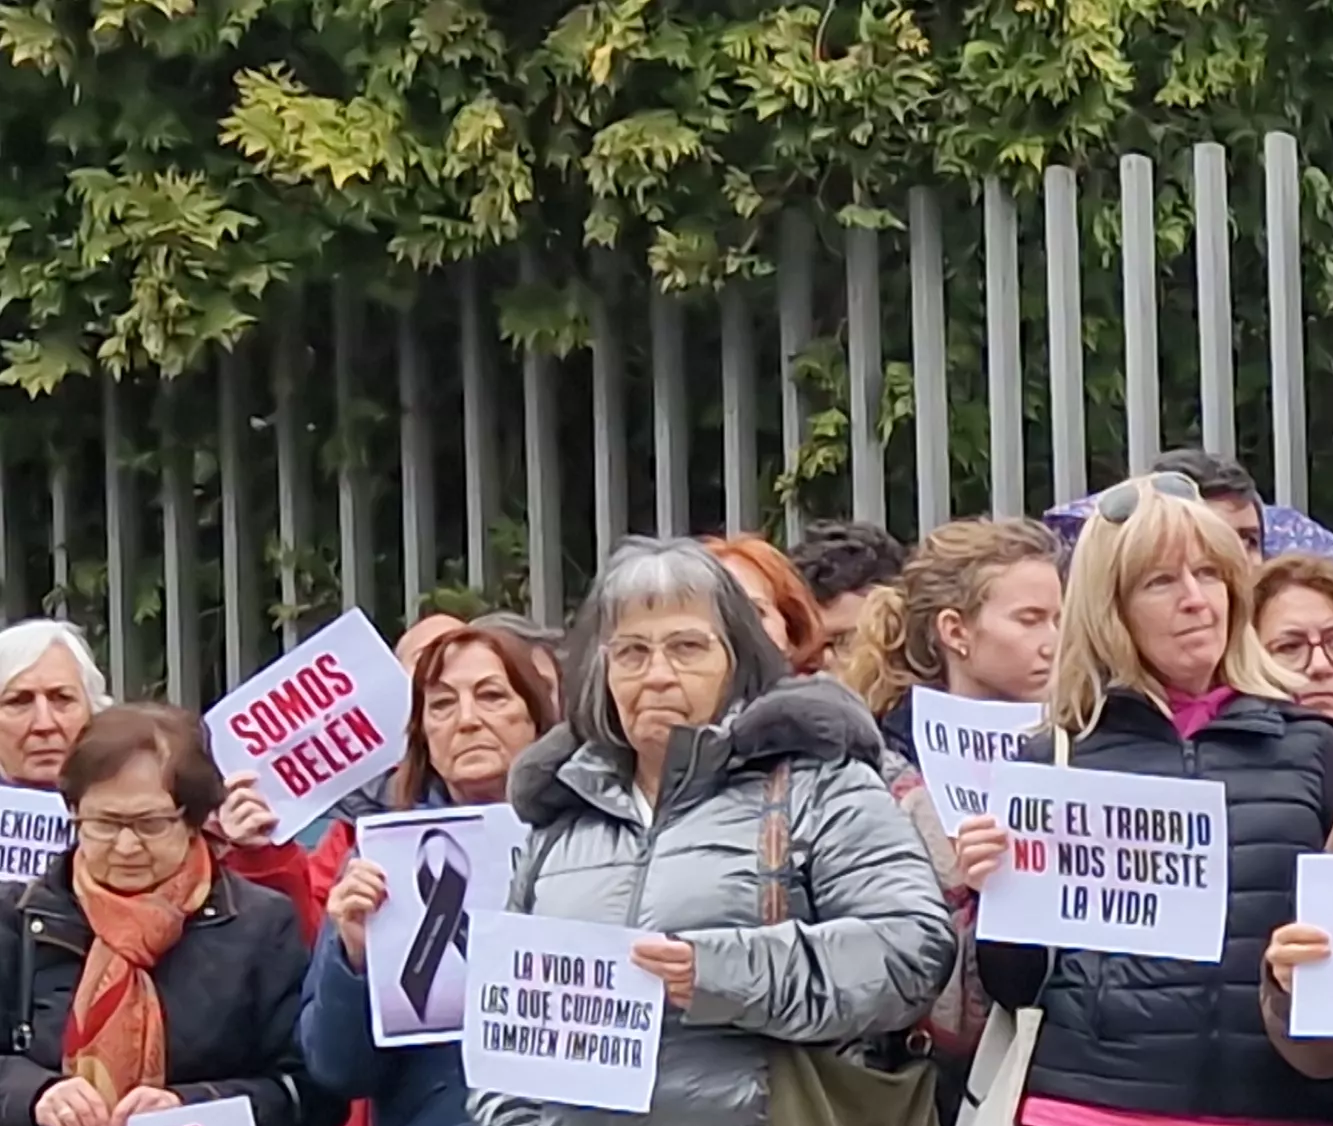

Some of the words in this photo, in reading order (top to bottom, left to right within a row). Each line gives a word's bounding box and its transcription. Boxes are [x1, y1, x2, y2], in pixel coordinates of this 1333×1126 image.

[230, 653, 353, 757] SOMOS
[271, 706, 384, 797] BELÉN
[925, 719, 949, 755] LA
[1008, 796, 1054, 834] QUE
[1066, 801, 1091, 837] EL
[1103, 804, 1211, 849] TRABAJO
[1012, 839, 1046, 872] NO
[1057, 842, 1105, 878] NOS
[1117, 848, 1208, 888] CUESTE
[1061, 884, 1088, 920] LA
[1101, 888, 1158, 927] VIDA
[514, 950, 533, 981] LA
[542, 953, 585, 987] VIDA
[594, 959, 617, 990] DE
[481, 983, 510, 1015] LAS
[517, 987, 552, 1021] QUE
[561, 992, 653, 1031] CUIDAMOS
[564, 1030, 642, 1069] IMPORTA
